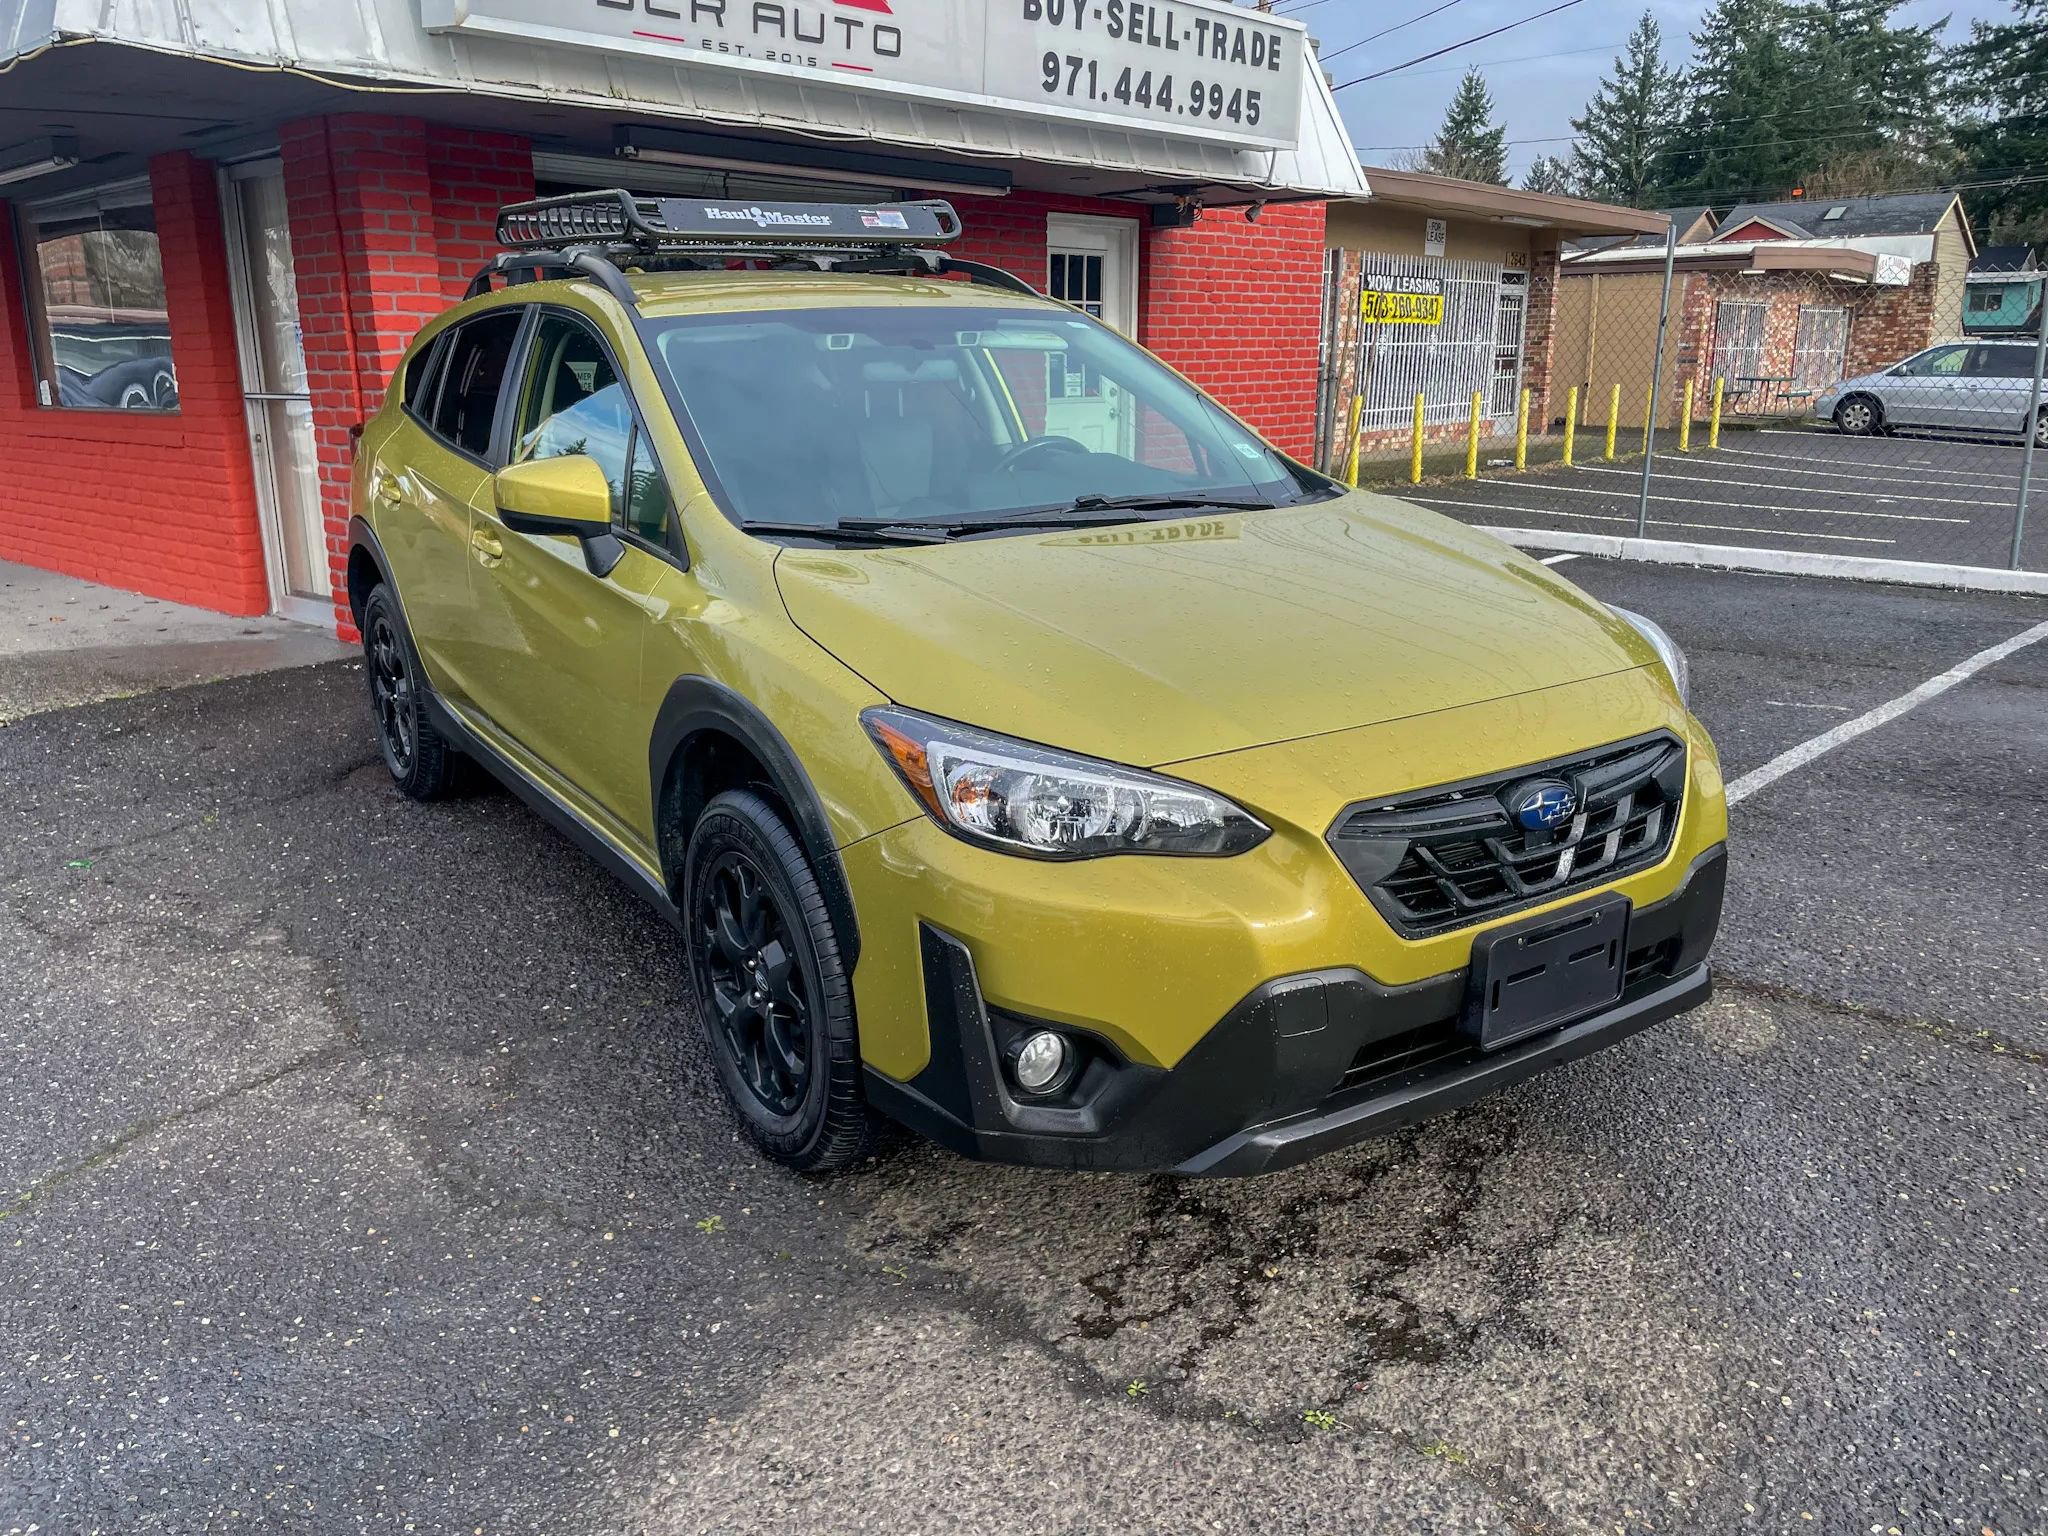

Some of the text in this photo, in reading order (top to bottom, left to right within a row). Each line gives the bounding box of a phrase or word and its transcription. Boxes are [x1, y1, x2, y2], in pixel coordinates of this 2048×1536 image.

[753, 2, 901, 58] AUTO
[1023, 0, 1281, 72] BUY-SELL-TRADE
[702, 39, 817, 67] EST. 2015
[1041, 51, 1261, 126] 971.444.9945
[1426, 231, 1445, 243] LEASE
[1431, 221, 1441, 231] FOR
[1367, 274, 1440, 294] NOW LEASING
